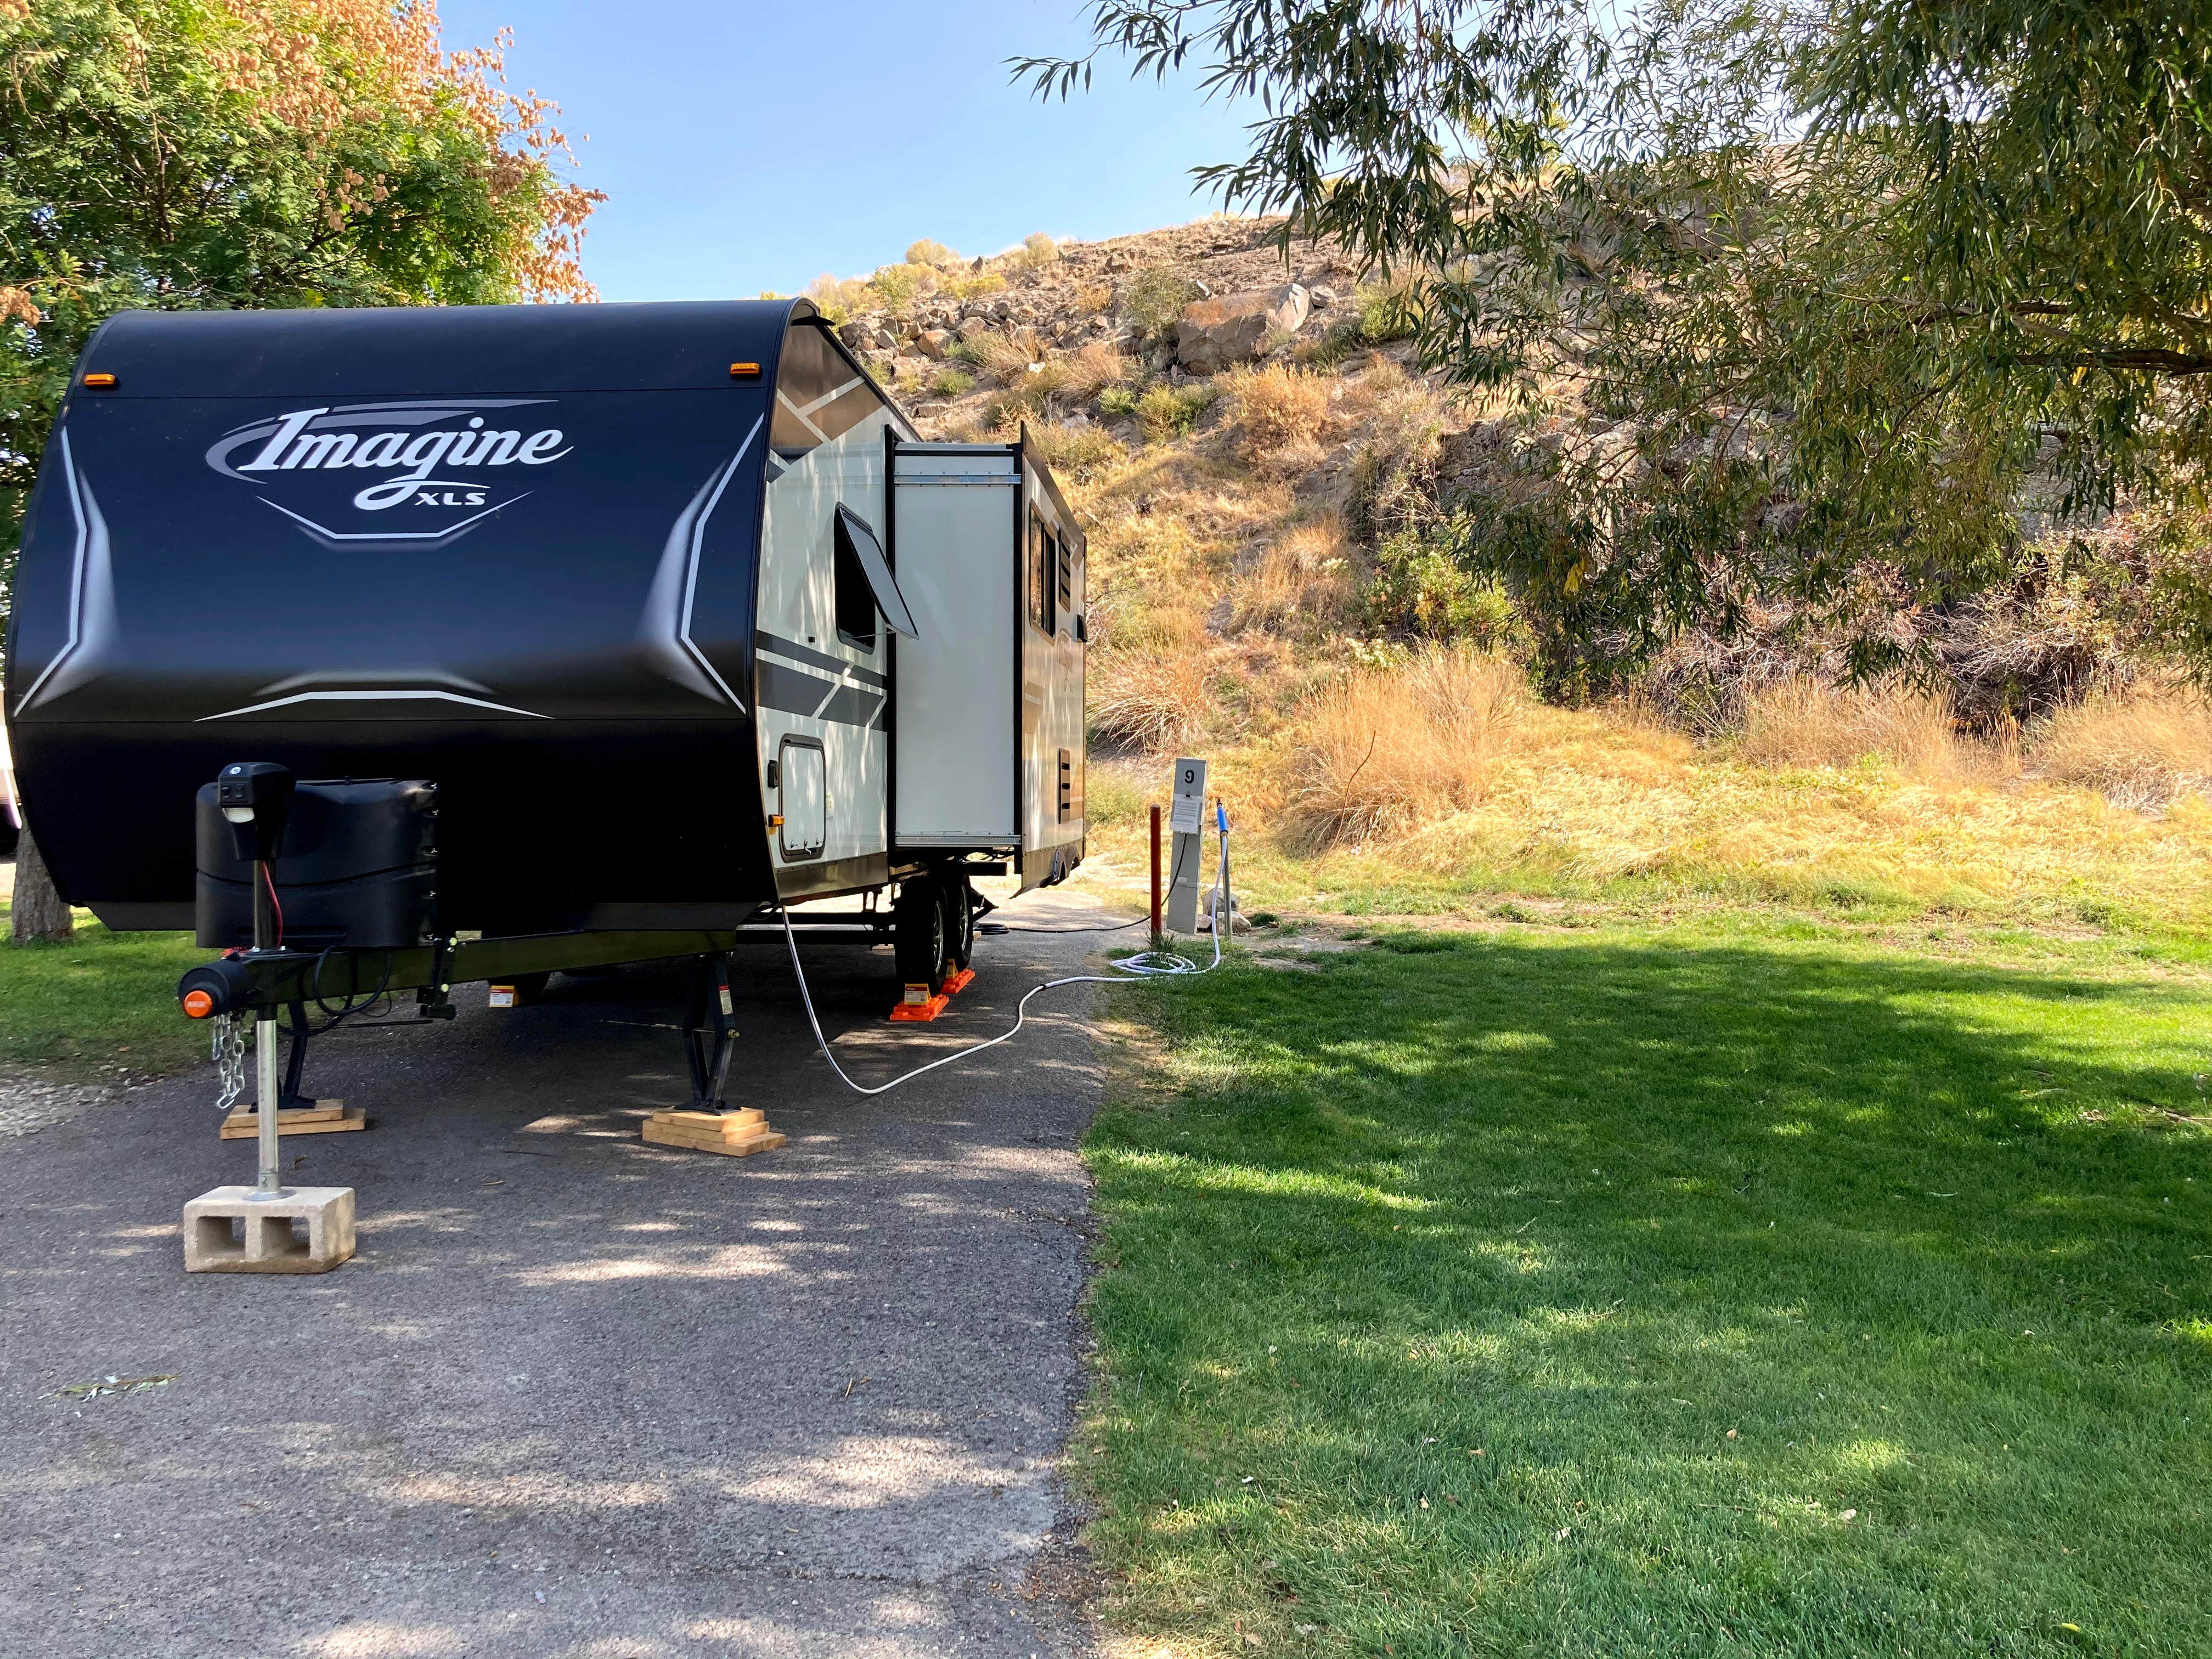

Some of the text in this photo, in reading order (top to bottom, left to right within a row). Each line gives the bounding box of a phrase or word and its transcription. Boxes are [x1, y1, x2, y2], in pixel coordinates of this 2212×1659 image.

[237, 408, 574, 510] Imagine
[415, 492, 486, 506] XLS
[1184, 769, 1195, 784] 9
